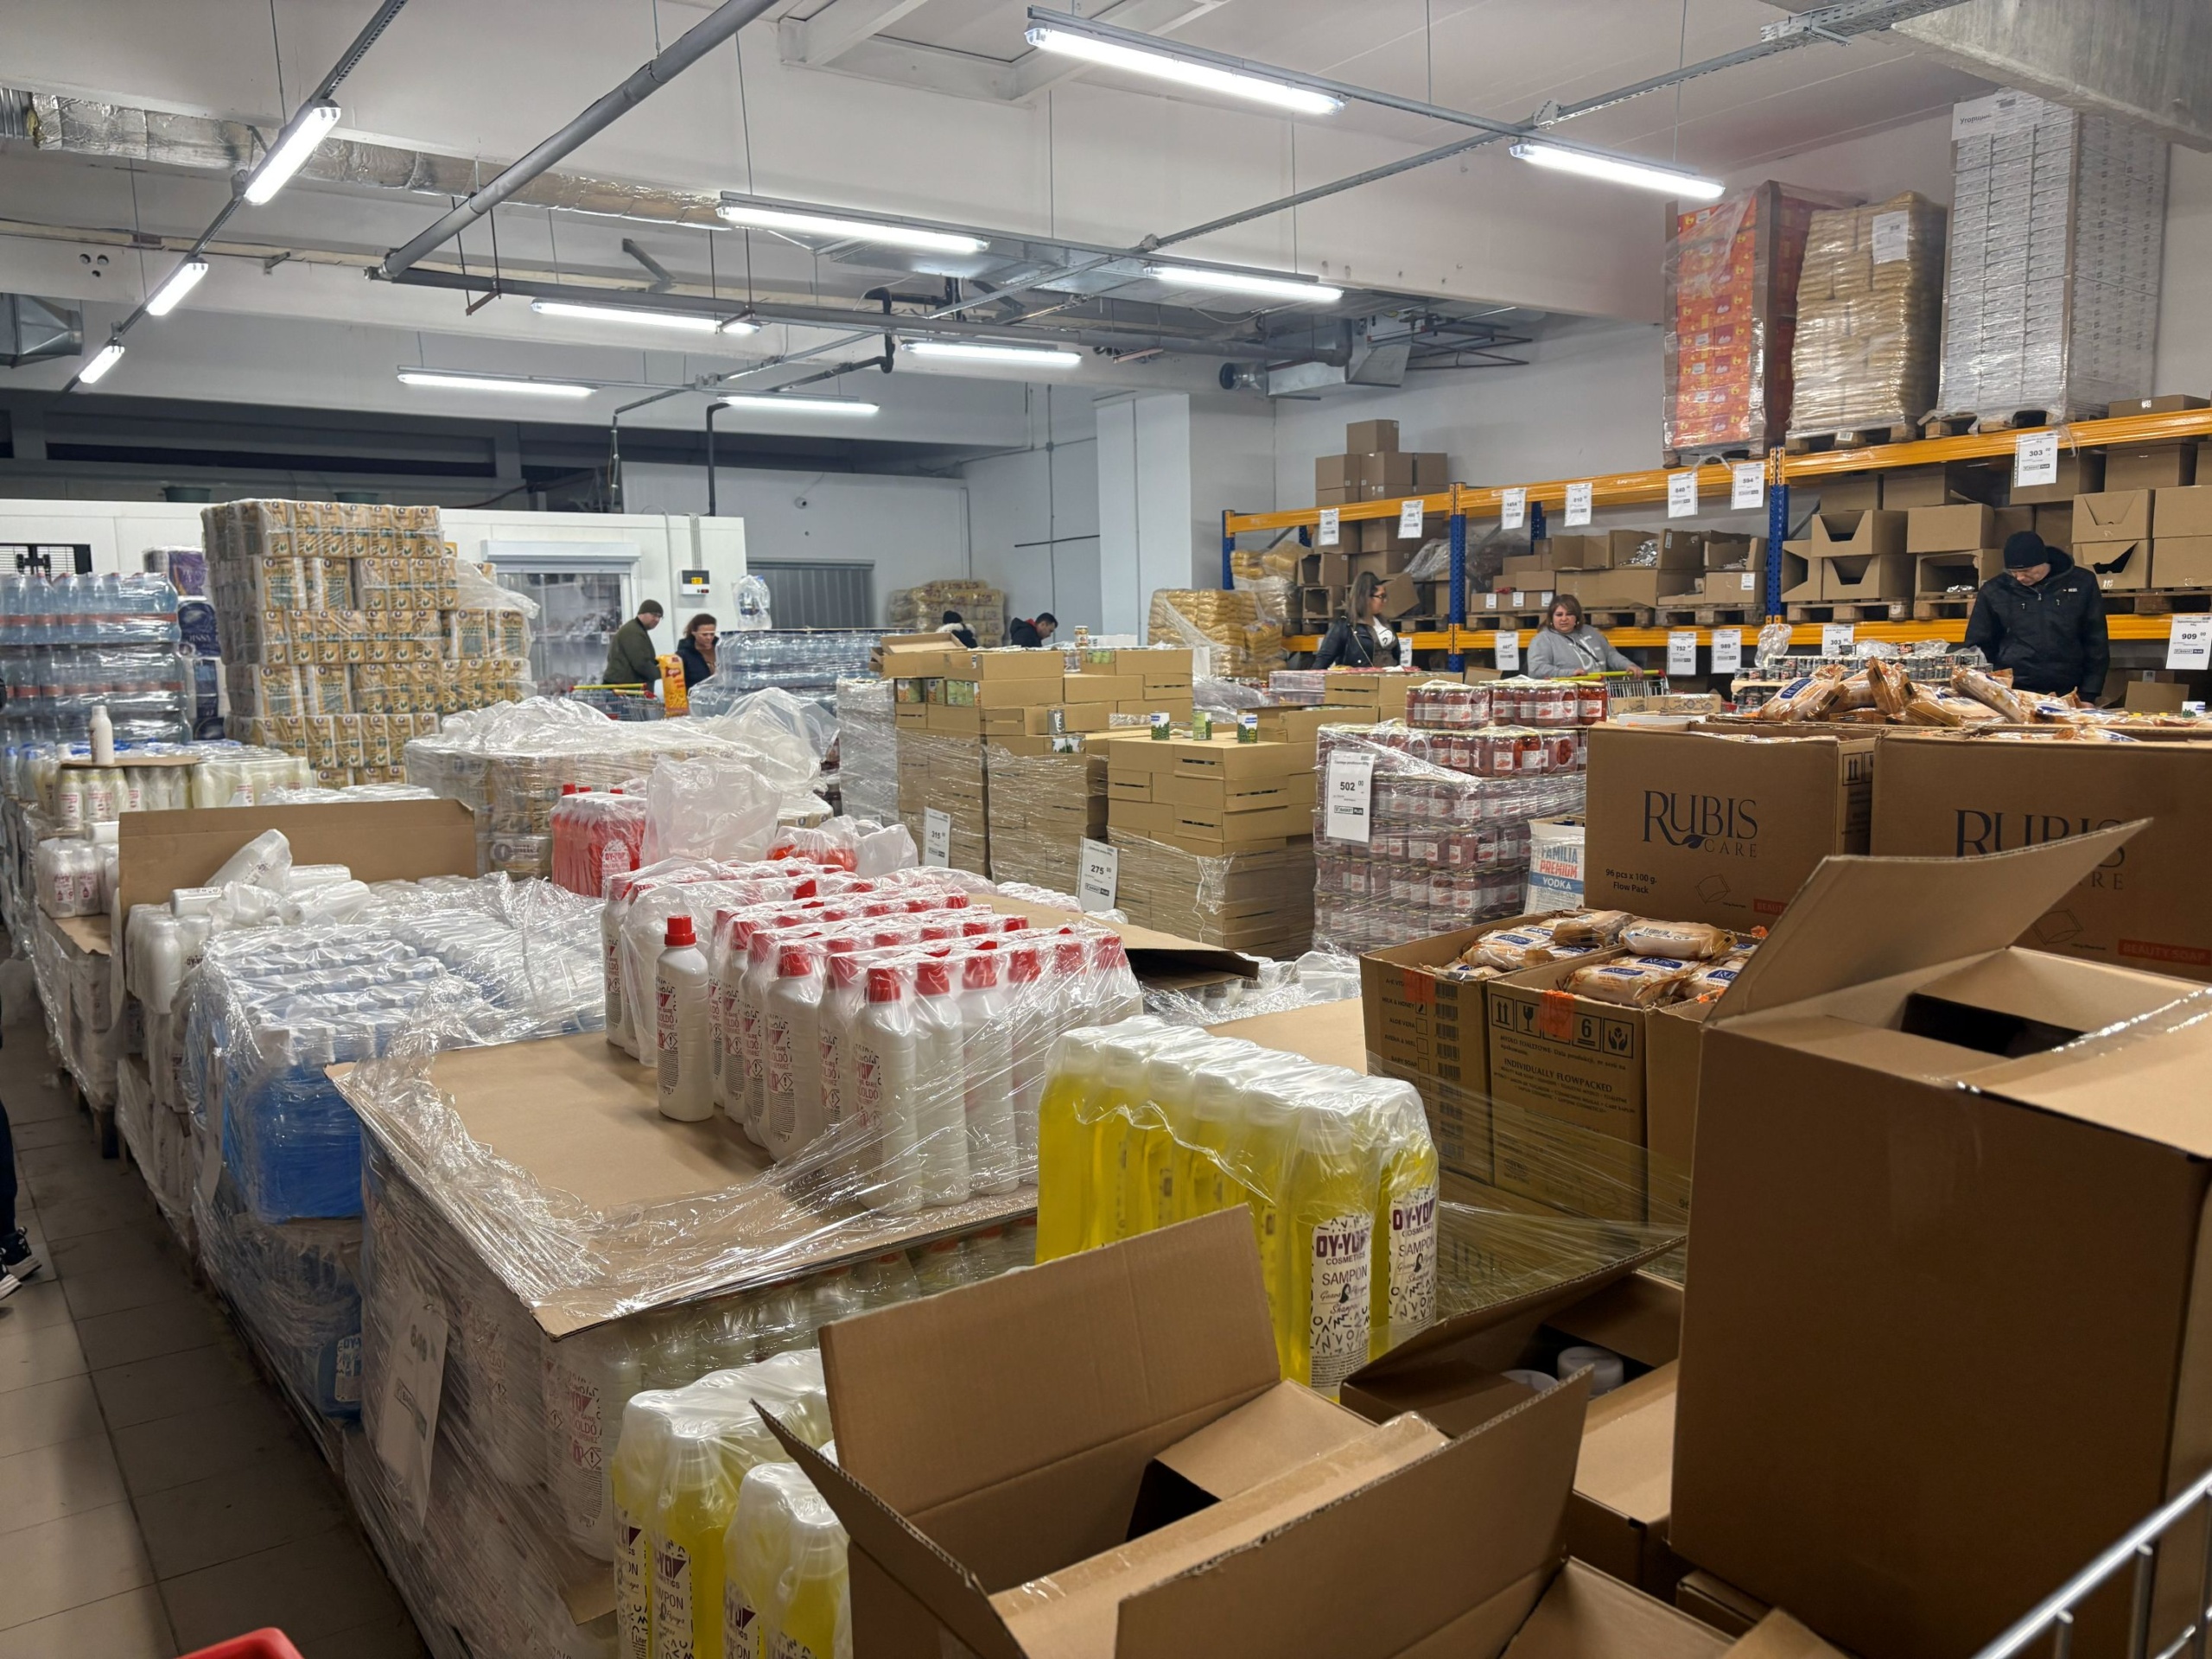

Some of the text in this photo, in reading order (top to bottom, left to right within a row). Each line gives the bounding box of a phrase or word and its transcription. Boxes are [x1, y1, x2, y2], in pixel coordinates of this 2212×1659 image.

[1340, 781, 1356, 791] 502
[1643, 791, 1758, 846] RUBIS
[1541, 844, 1578, 864] FAMILIA
[1704, 838, 1758, 857] CARE
[1090, 864, 1104, 875] 275
[1540, 859, 1578, 879] PREMIUM
[1605, 868, 1614, 877] 96
[1616, 870, 1628, 880] pcs
[1635, 873, 1649, 882] 100
[1542, 876, 1572, 890] VODKA
[1613, 881, 1649, 894] Flow Pack
[1757, 901, 1785, 913] BEAUT
[2123, 943, 2169, 957] BEAUTY
[2171, 949, 2206, 963] SOAP
[1398, 1001, 1414, 1009] HONEY
[1402, 1020, 1415, 1028] VERA
[1581, 1018, 1592, 1039] 6
[1405, 1058, 1417, 1068] SOAP
[1504, 1058, 1612, 1093] INDIVIDUALLY FLOWPACKED
[1399, 1234, 1435, 1258] SAMPON
[1325, 1250, 1366, 1266] COSMETICS
[1322, 1263, 1368, 1287] SAMPON
